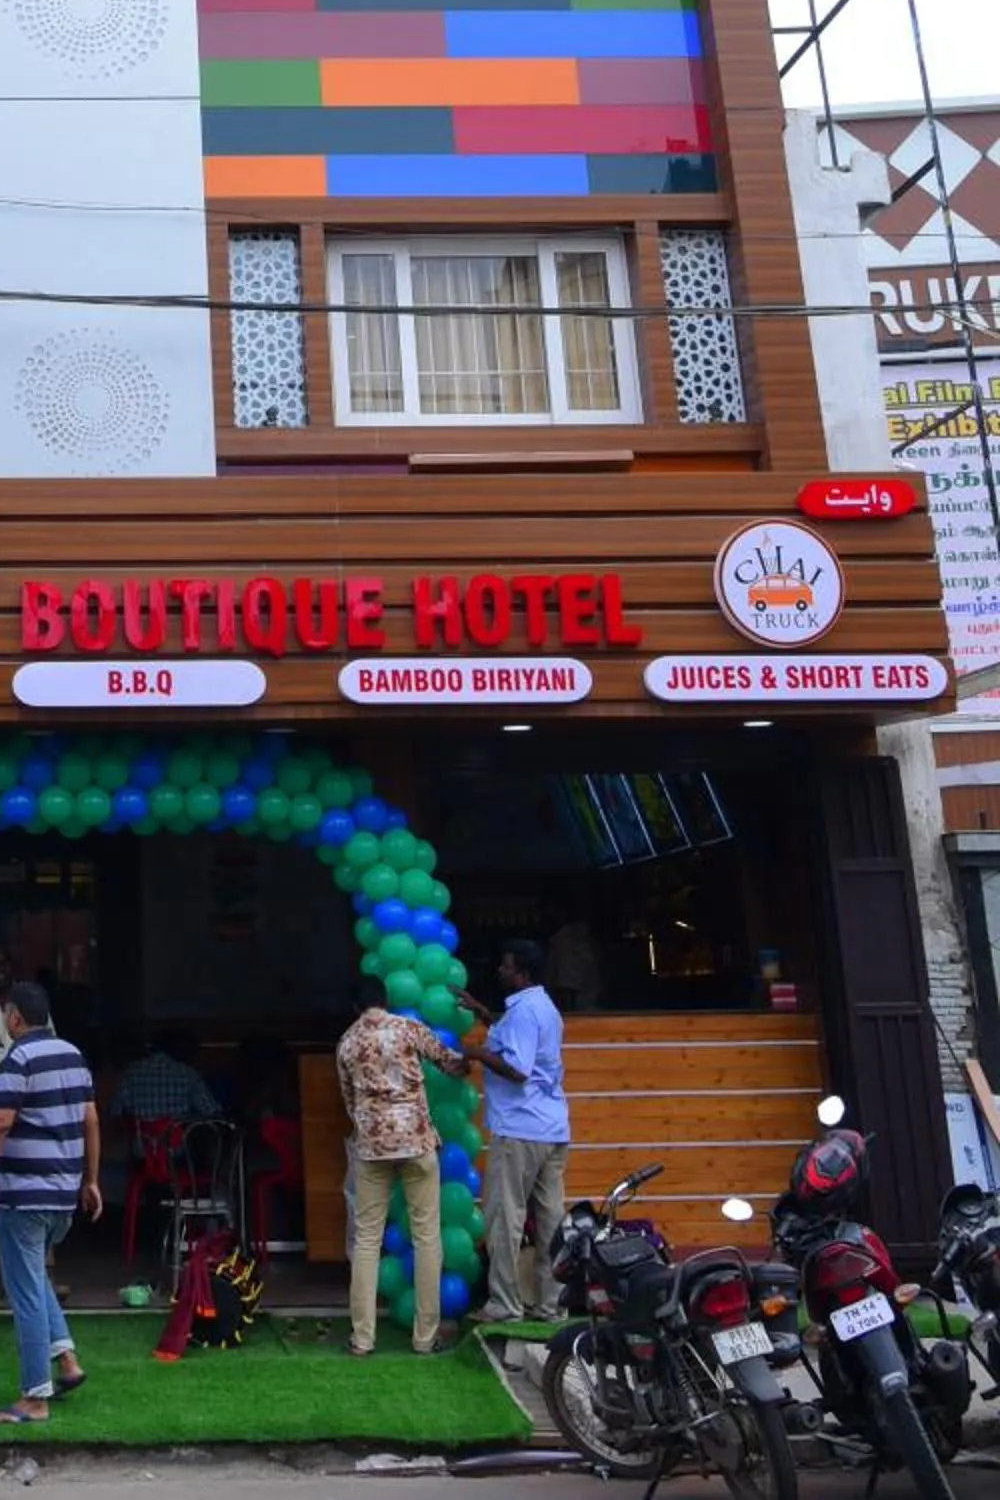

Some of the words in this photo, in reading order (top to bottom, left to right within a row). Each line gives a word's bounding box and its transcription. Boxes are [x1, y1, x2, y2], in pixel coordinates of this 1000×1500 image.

[21, 578, 385, 655] BOUTIQUE
[412, 573, 643, 647] HOTEL
[752, 612, 820, 629] TRUCK
[107, 670, 173, 695] B.B.Q
[359, 668, 463, 693] BAMBOO
[471, 668, 576, 692] BIRIYANI
[666, 666, 752, 690] JUICES
[759, 667, 778, 689] &
[785, 666, 863, 689] SHORT
[871, 665, 930, 689] EATS
